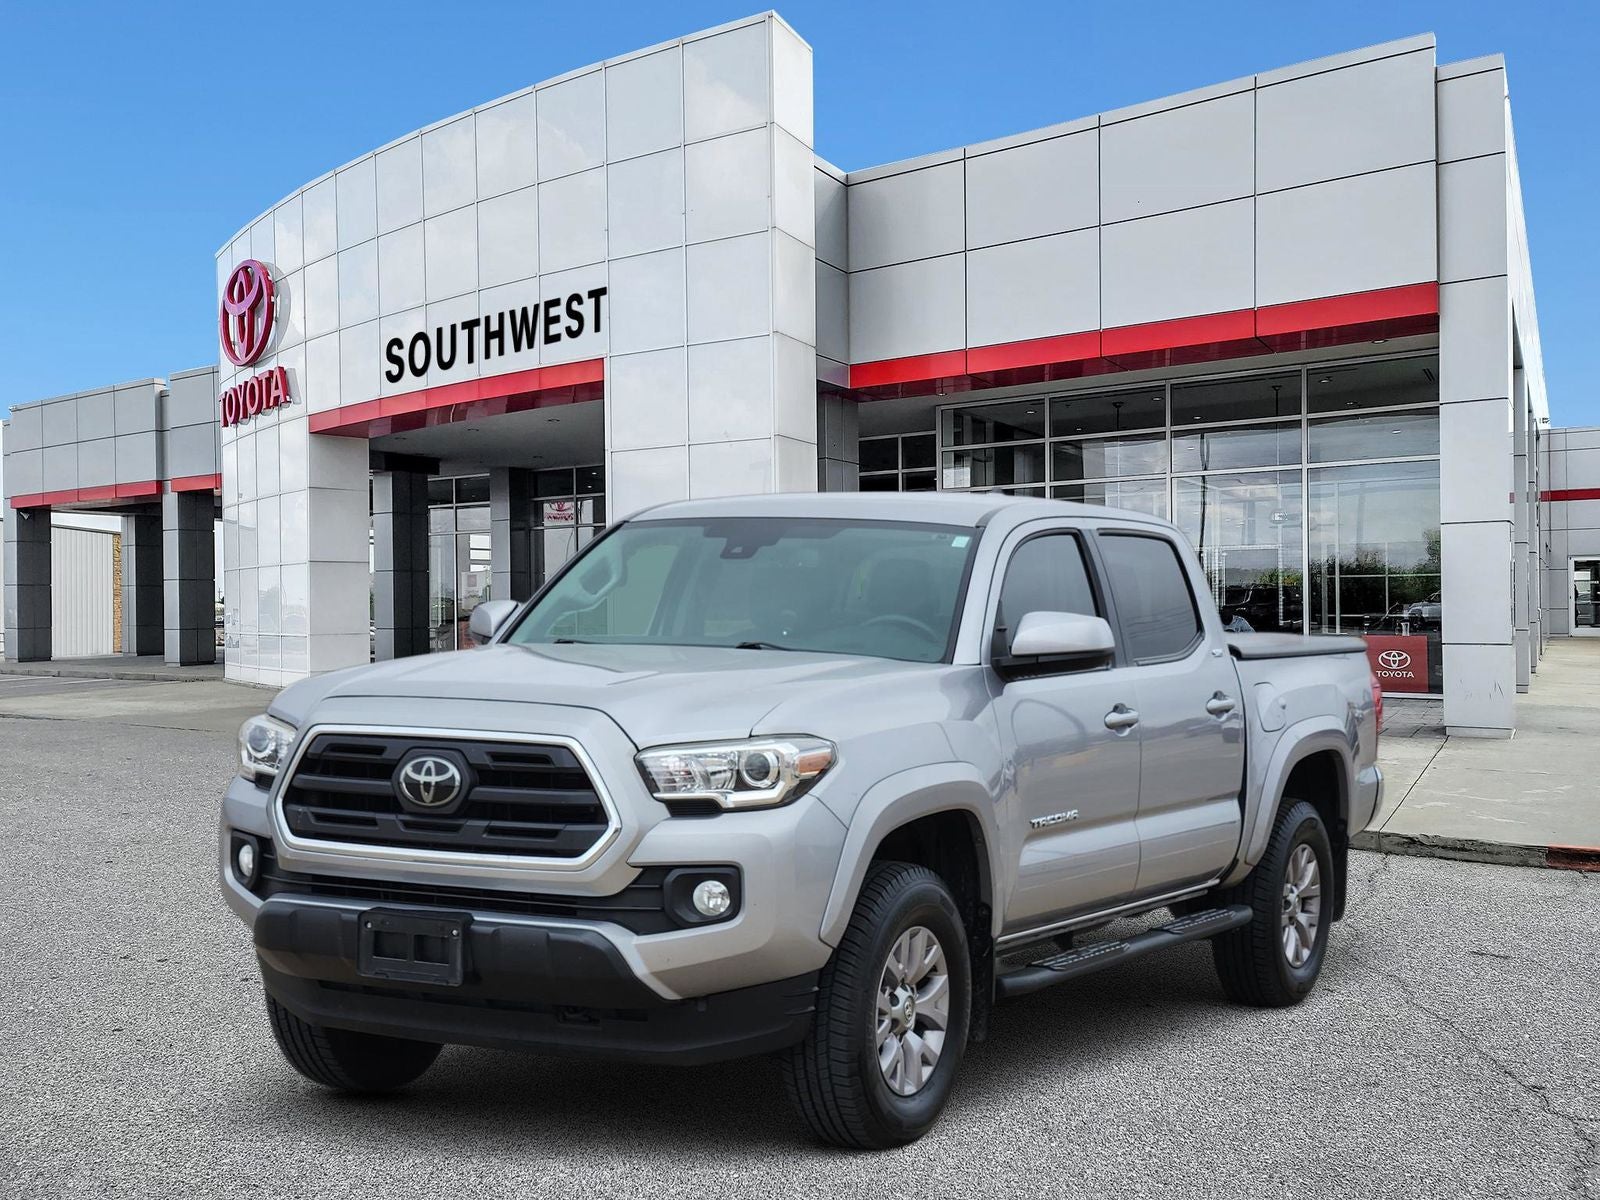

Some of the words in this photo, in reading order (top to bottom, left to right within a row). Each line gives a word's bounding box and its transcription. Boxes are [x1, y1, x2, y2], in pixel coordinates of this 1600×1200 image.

[385, 286, 607, 384] SOUTHWEST
[219, 366, 291, 428] TOYOTA
[1376, 670, 1415, 678] TOYOTA
